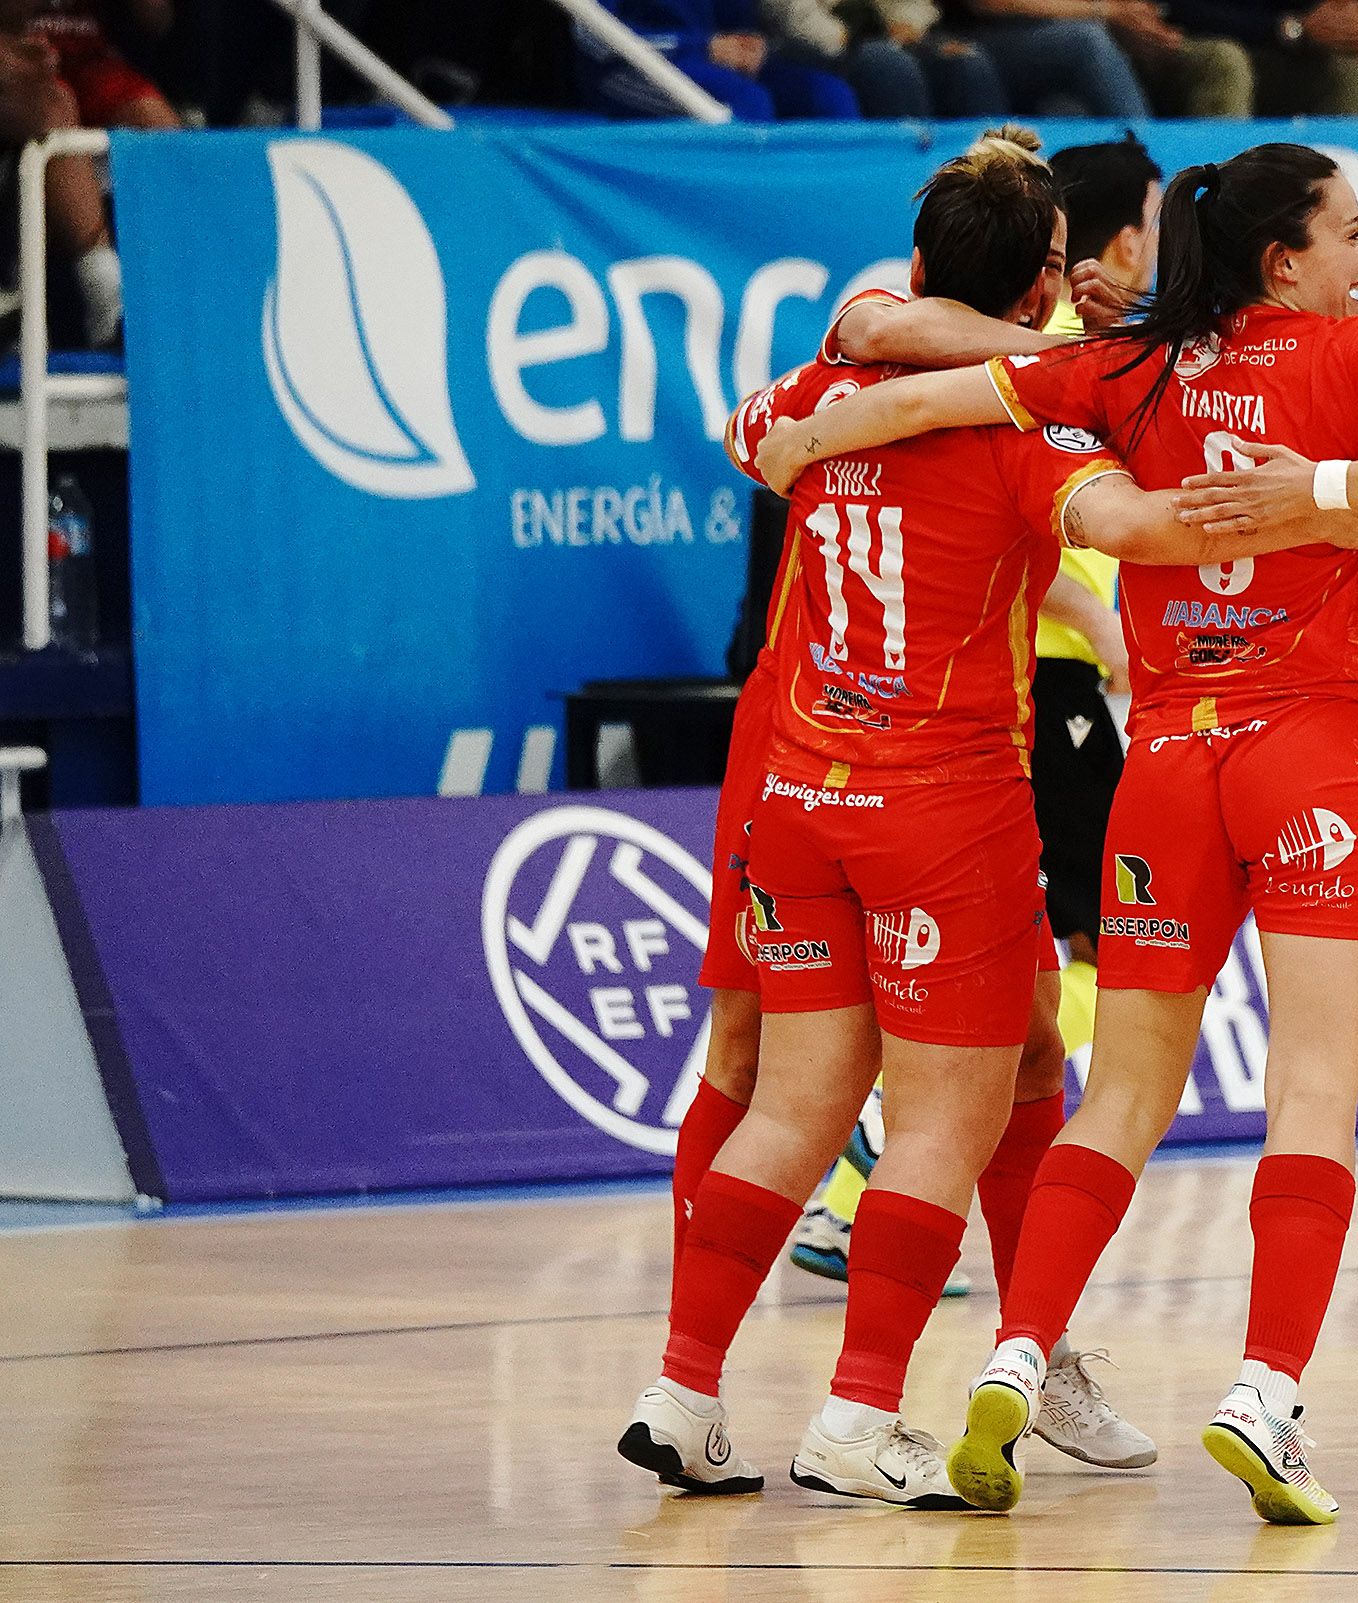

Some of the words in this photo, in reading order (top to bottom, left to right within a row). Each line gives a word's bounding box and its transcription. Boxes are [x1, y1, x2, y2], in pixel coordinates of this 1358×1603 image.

[1223, 351, 1238, 365] DE
[1239, 353, 1275, 367] POIO
[823, 461, 882, 496] CHULI
[512, 474, 694, 548] ENERGÍA
[704, 487, 743, 545] &
[805, 503, 906, 671] 14
[566, 920, 671, 976] RF
[588, 984, 694, 1041] EF
